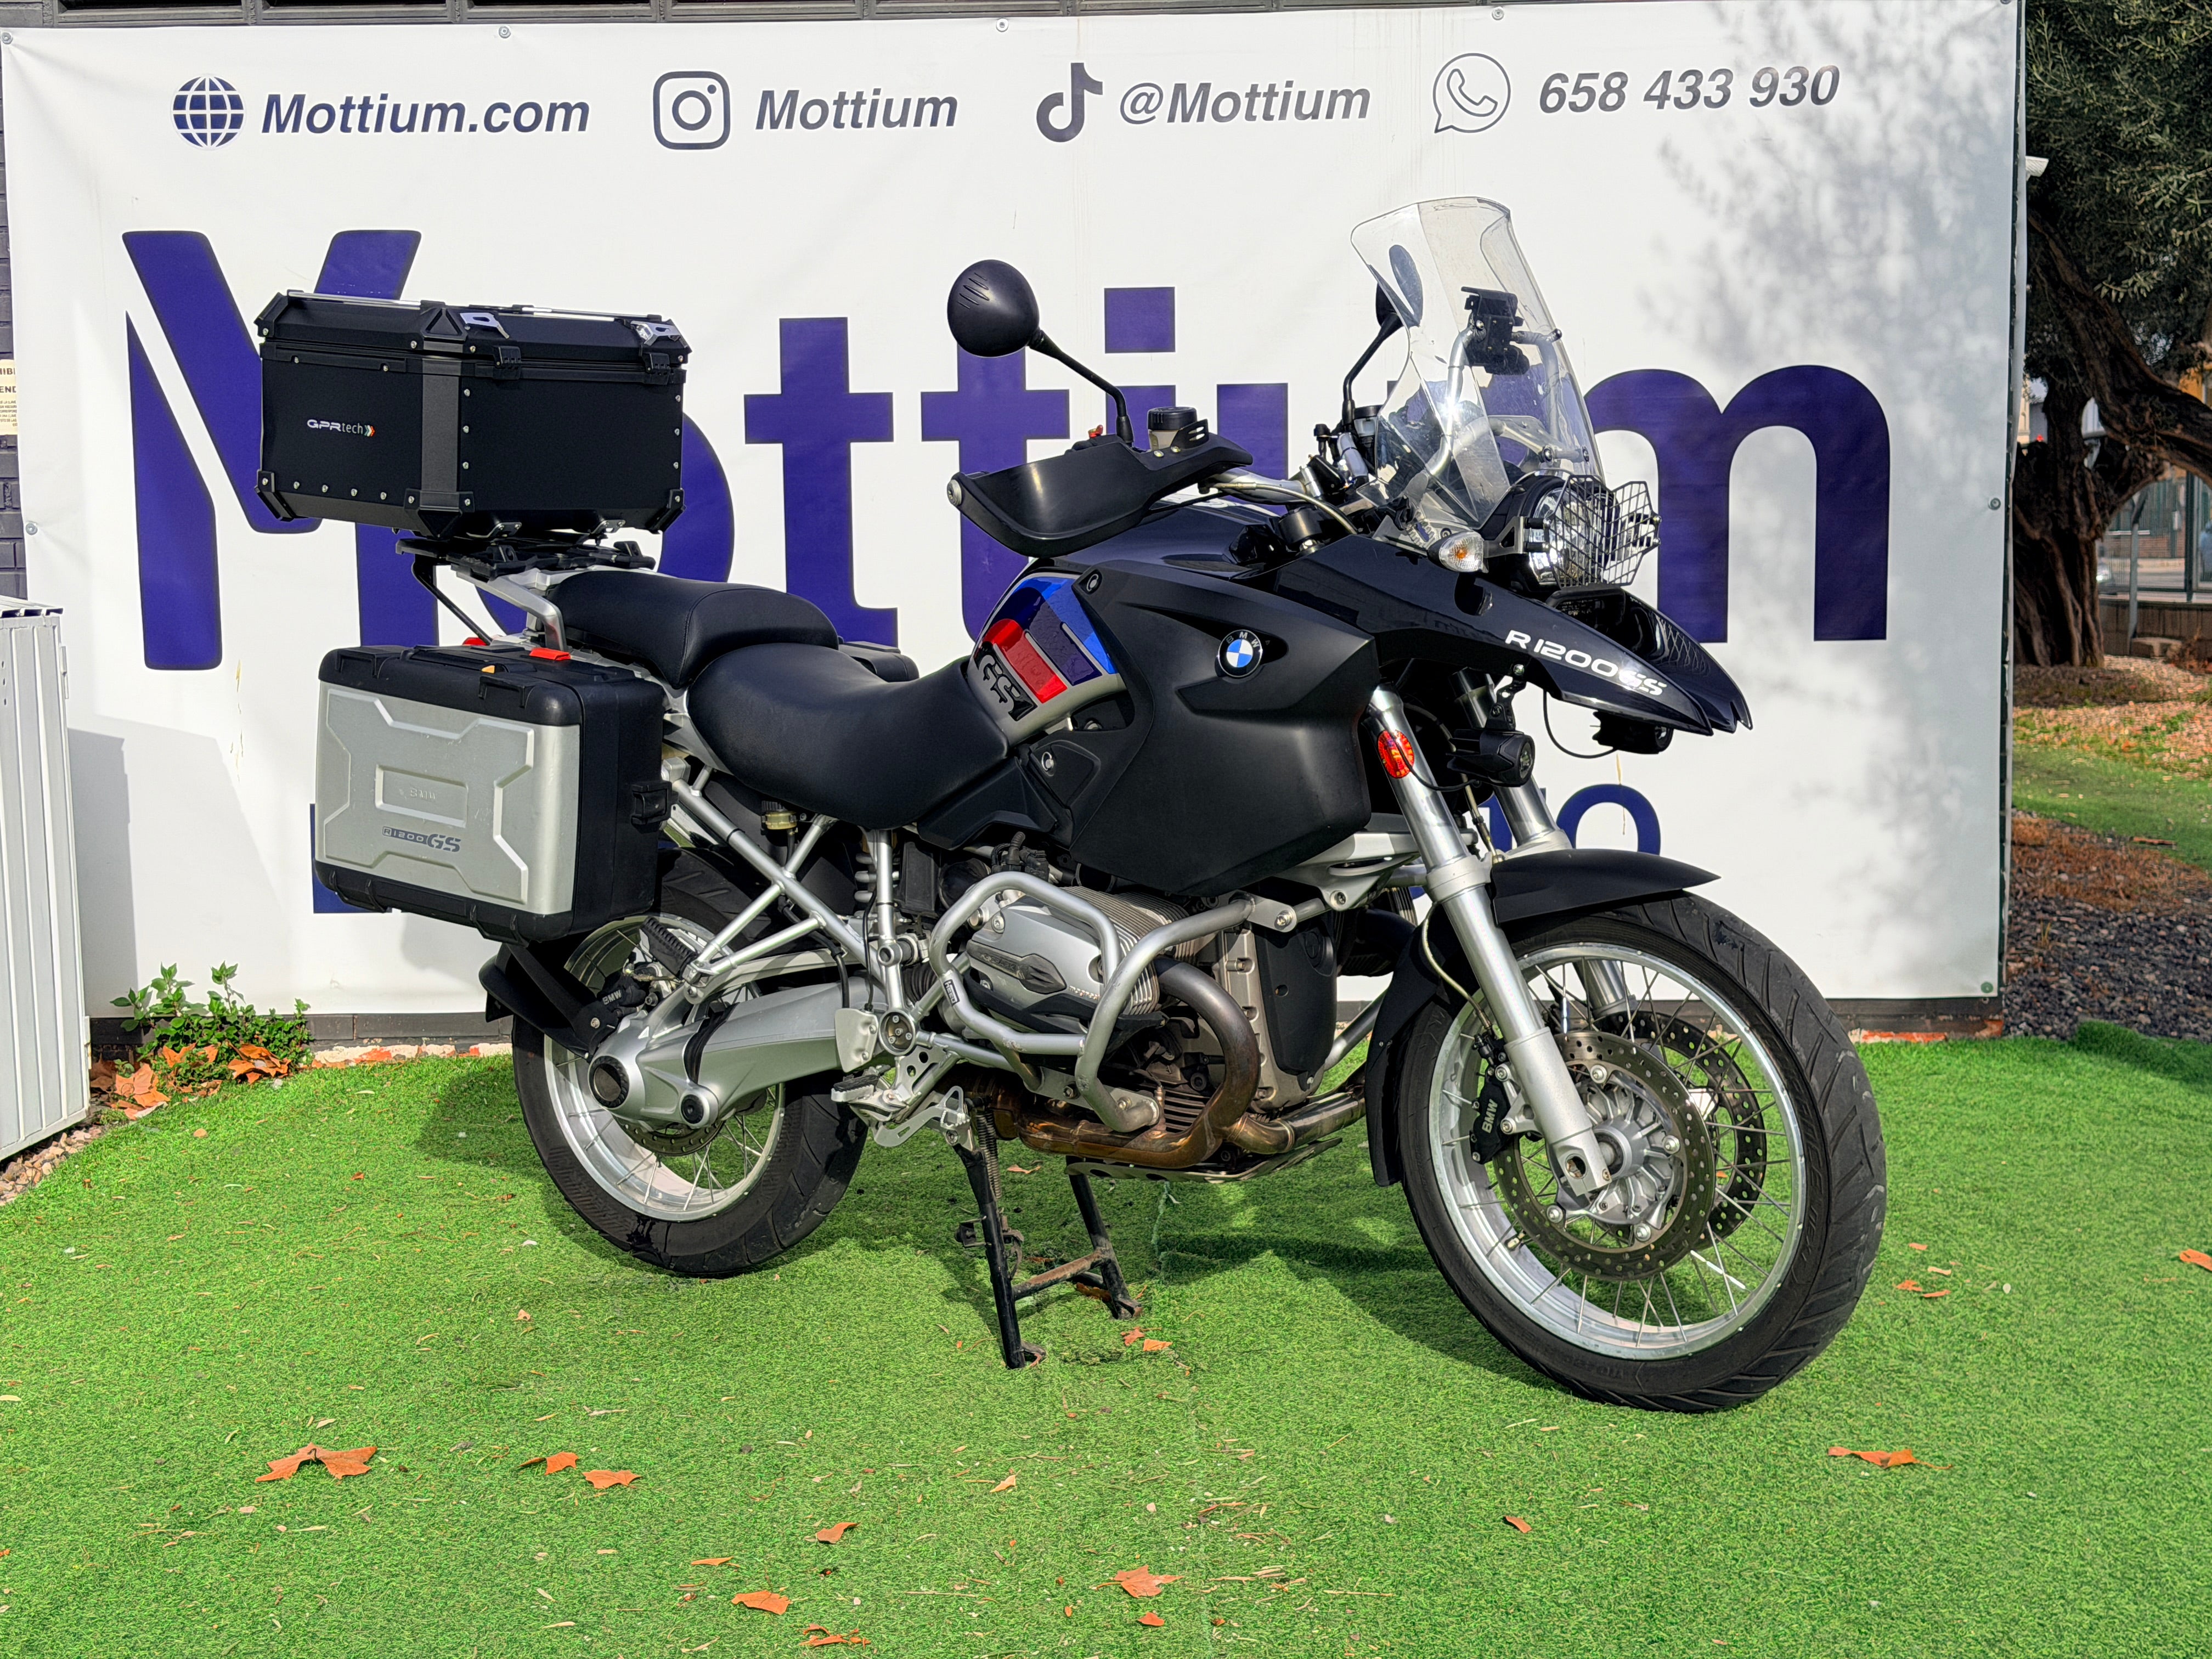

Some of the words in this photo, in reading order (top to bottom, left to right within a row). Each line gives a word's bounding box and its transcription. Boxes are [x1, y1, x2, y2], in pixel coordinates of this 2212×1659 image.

[1120, 81, 1370, 125] @Mottium
[1540, 72, 1628, 113] 658
[1644, 69, 1734, 109] 433
[1750, 66, 1840, 107] 930
[261, 93, 589, 133] Mottium.com
[755, 88, 958, 129] Mottium
[307, 419, 363, 434] GPRtech
[1226, 631, 1260, 648] BMW
[602, 989, 622, 1005] BMW
[1482, 1098, 1498, 1133] BMW
